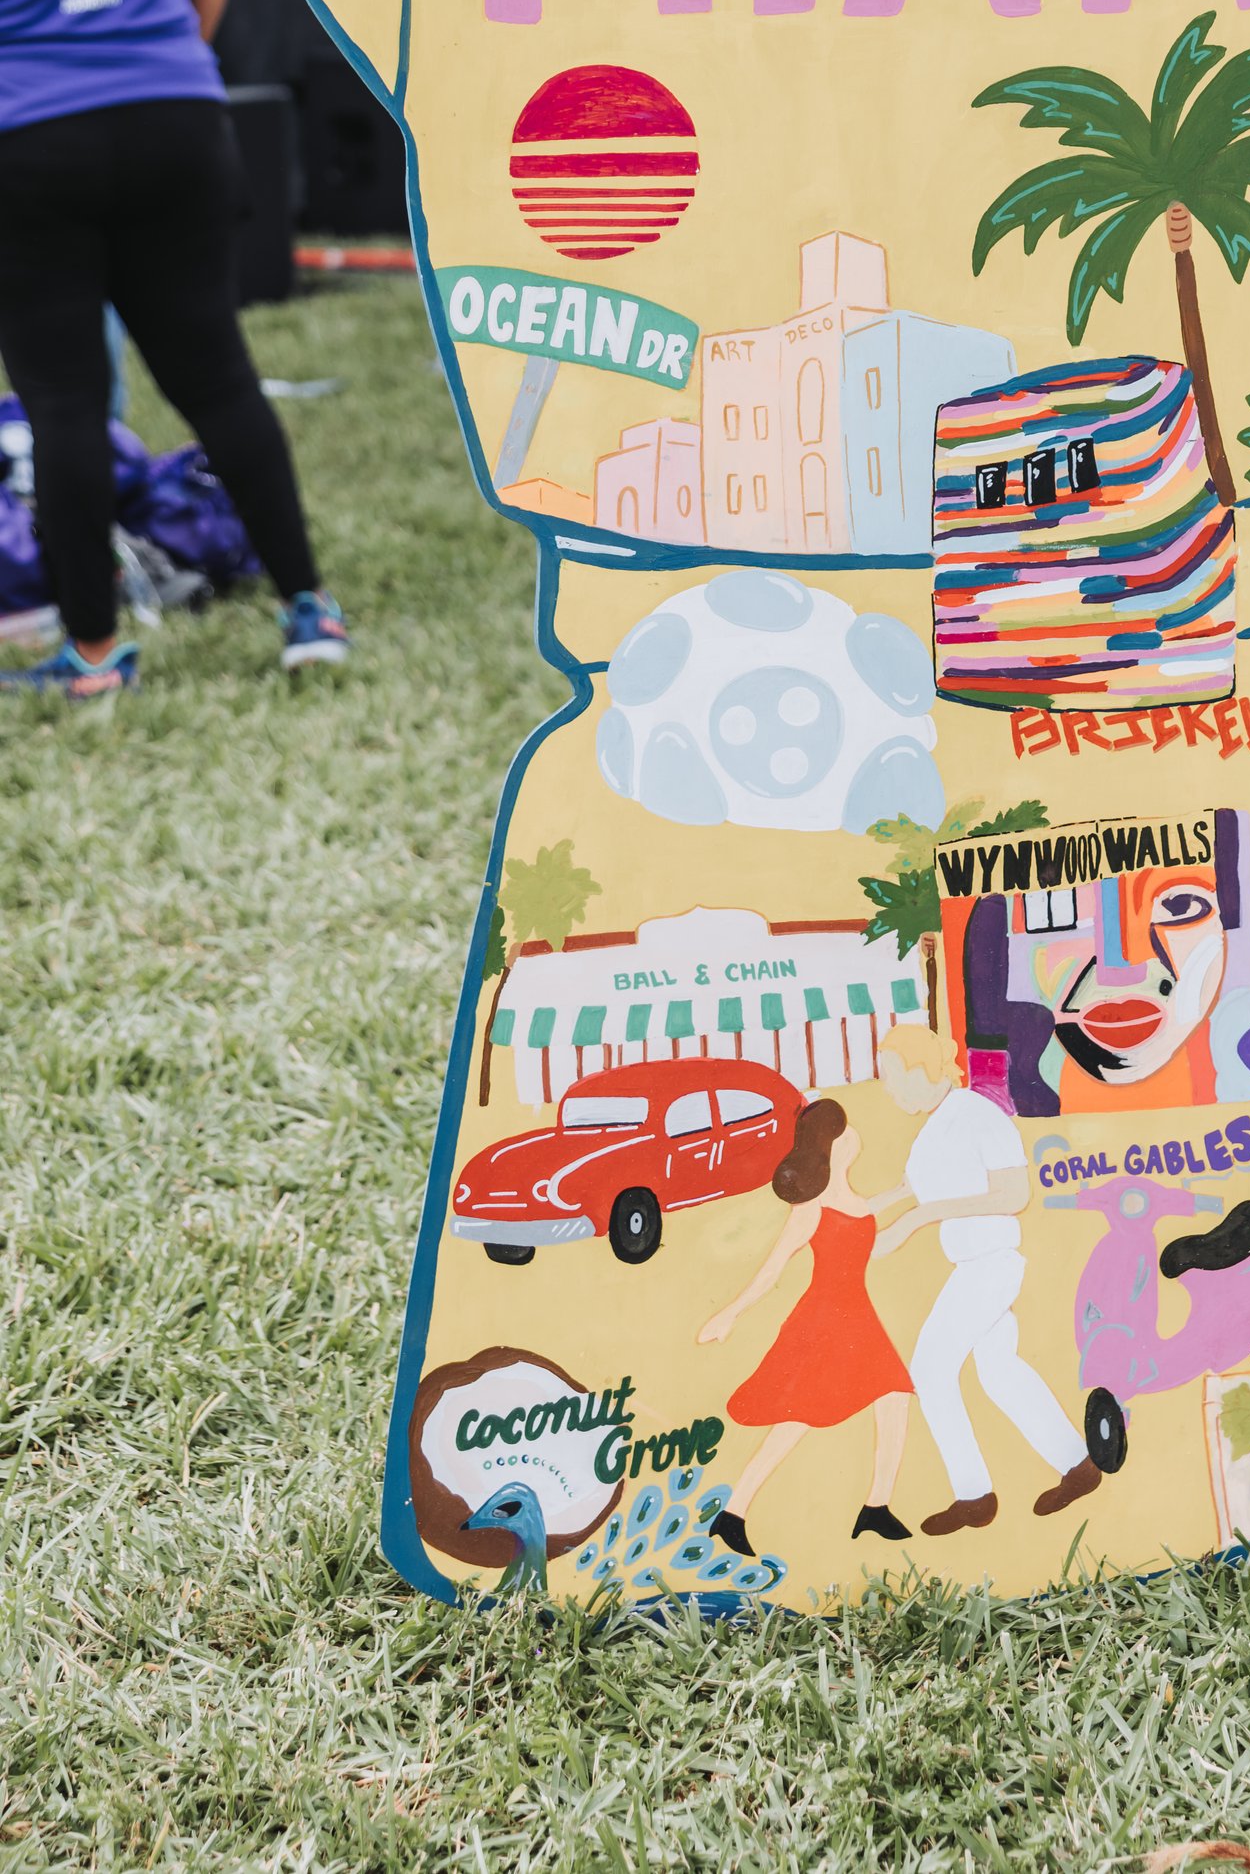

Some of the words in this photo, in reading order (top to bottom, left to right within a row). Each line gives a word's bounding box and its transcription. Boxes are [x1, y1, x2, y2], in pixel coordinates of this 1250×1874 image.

[449, 276, 639, 365] OCEAN
[636, 329, 689, 380] DR
[710, 340, 757, 362] ART
[785, 317, 834, 345] DECO
[938, 833, 1101, 896] WYNWOOD
[1102, 821, 1212, 873] WALLS
[613, 969, 677, 991] BALL
[694, 964, 710, 985] &
[725, 958, 798, 983] CHAIN
[1039, 1151, 1117, 1188] CORAL
[593, 1416, 725, 1485] Grove
